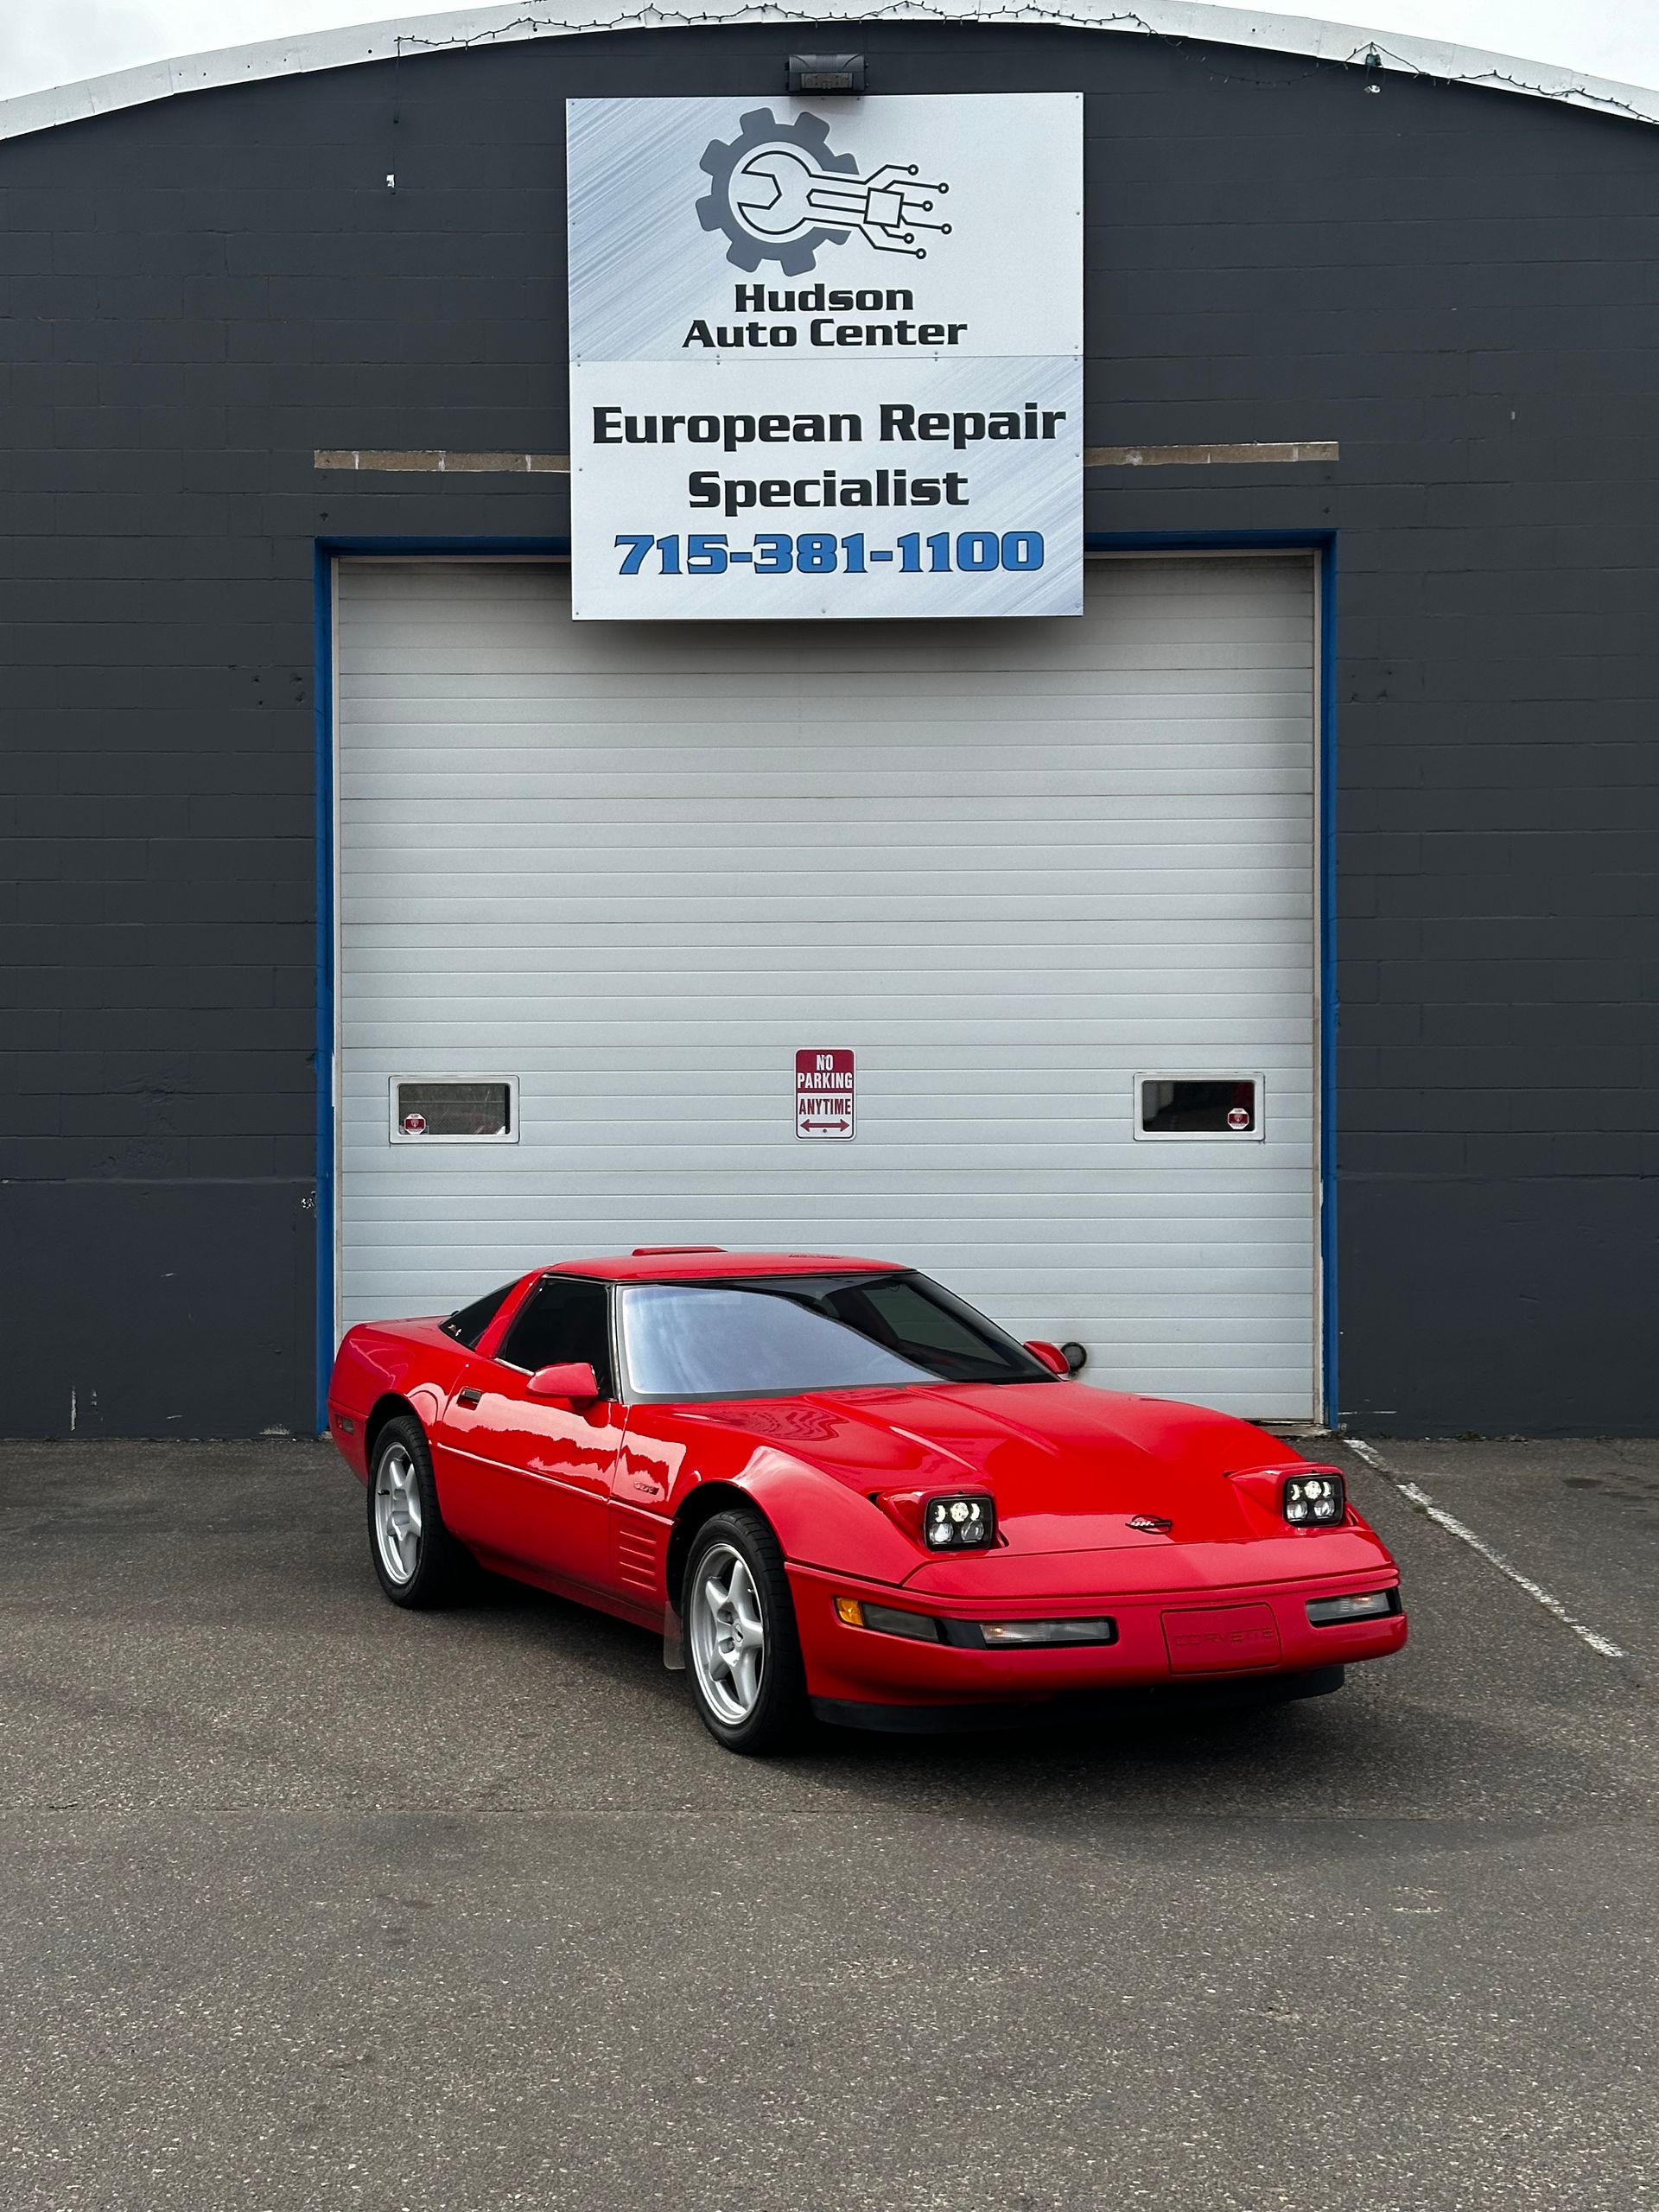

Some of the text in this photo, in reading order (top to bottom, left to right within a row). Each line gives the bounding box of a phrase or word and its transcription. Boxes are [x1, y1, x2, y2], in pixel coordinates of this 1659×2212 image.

[734, 283, 914, 313] Hudson
[681, 318, 968, 348] Auto Center
[592, 402, 1066, 453] European Repair
[689, 468, 969, 518] Specialist
[613, 531, 1045, 575] 715-381-1100
[816, 1054, 834, 1071] NO
[797, 1072, 853, 1089] PARKING
[799, 1098, 851, 1115] ANYTIME
[1173, 1627, 1274, 1647] CORVETTE
